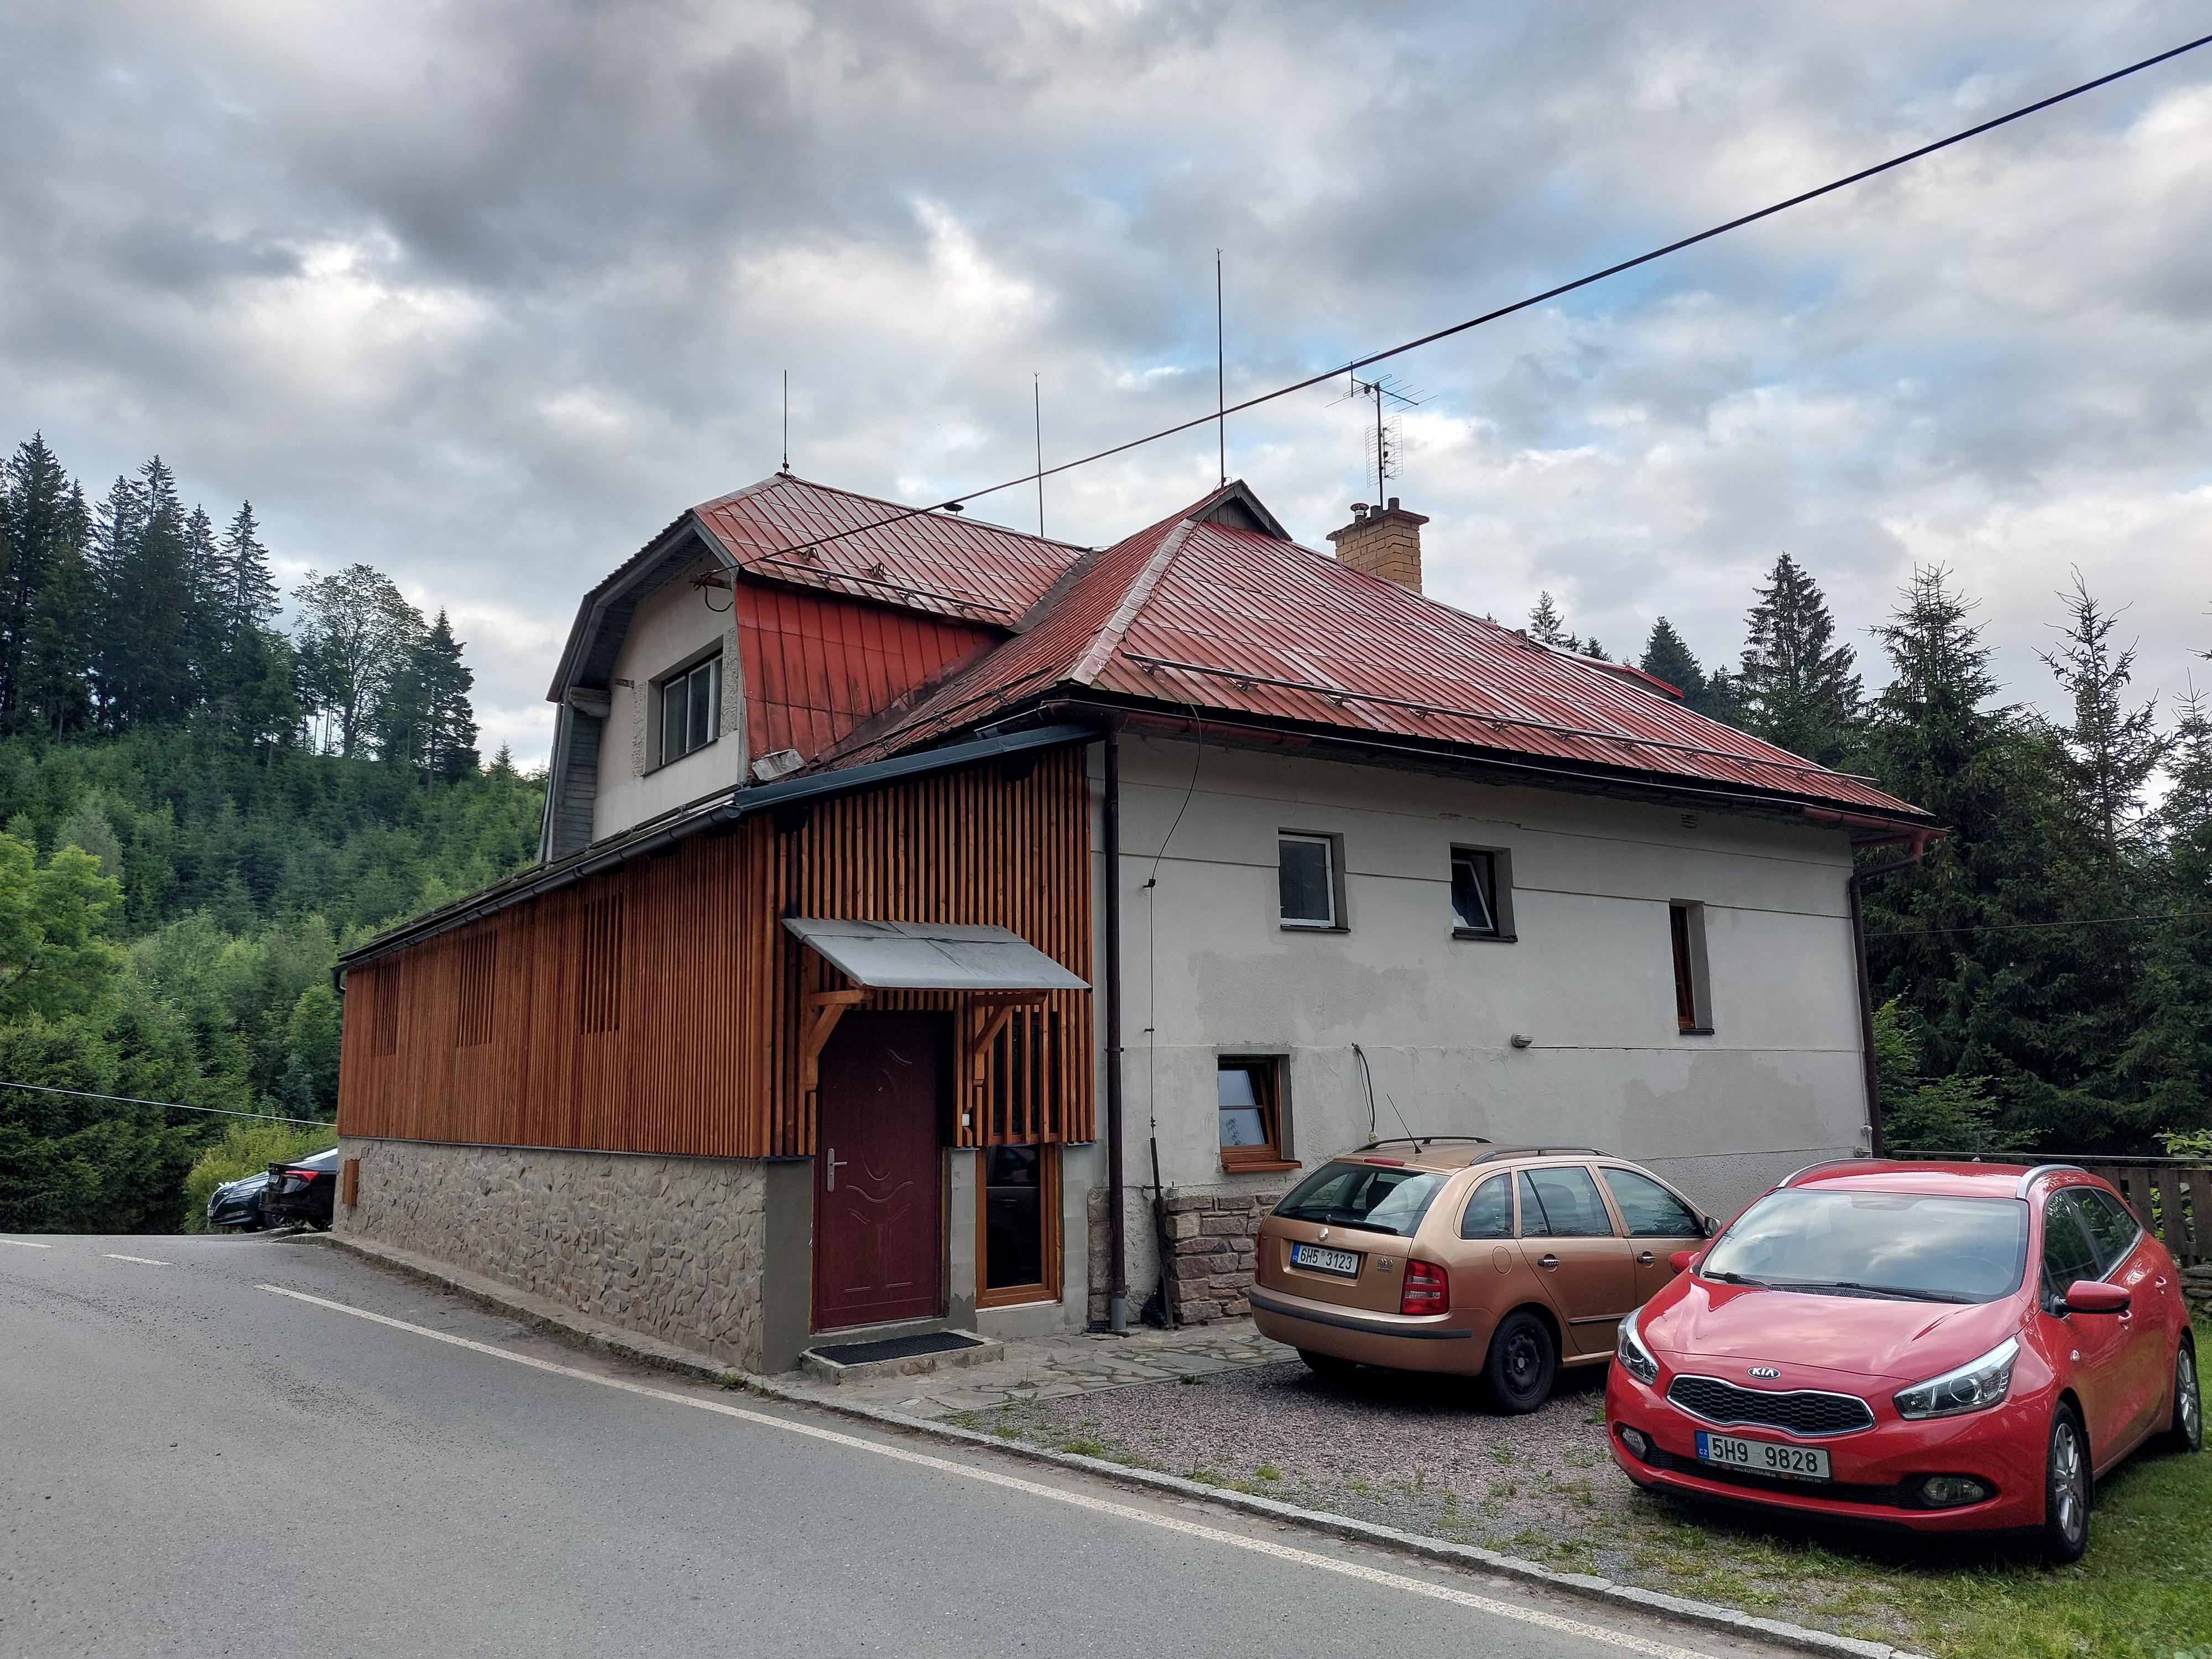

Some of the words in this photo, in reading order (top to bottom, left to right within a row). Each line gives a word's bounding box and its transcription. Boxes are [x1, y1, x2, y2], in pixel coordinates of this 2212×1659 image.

[1300, 1248, 1319, 1264] 6H5
[1325, 1251, 1353, 1270] 3123
[1752, 1368, 1774, 1377] KIA
[1712, 1437, 1749, 1463] 5H9
[1765, 1446, 1818, 1473] 9828
